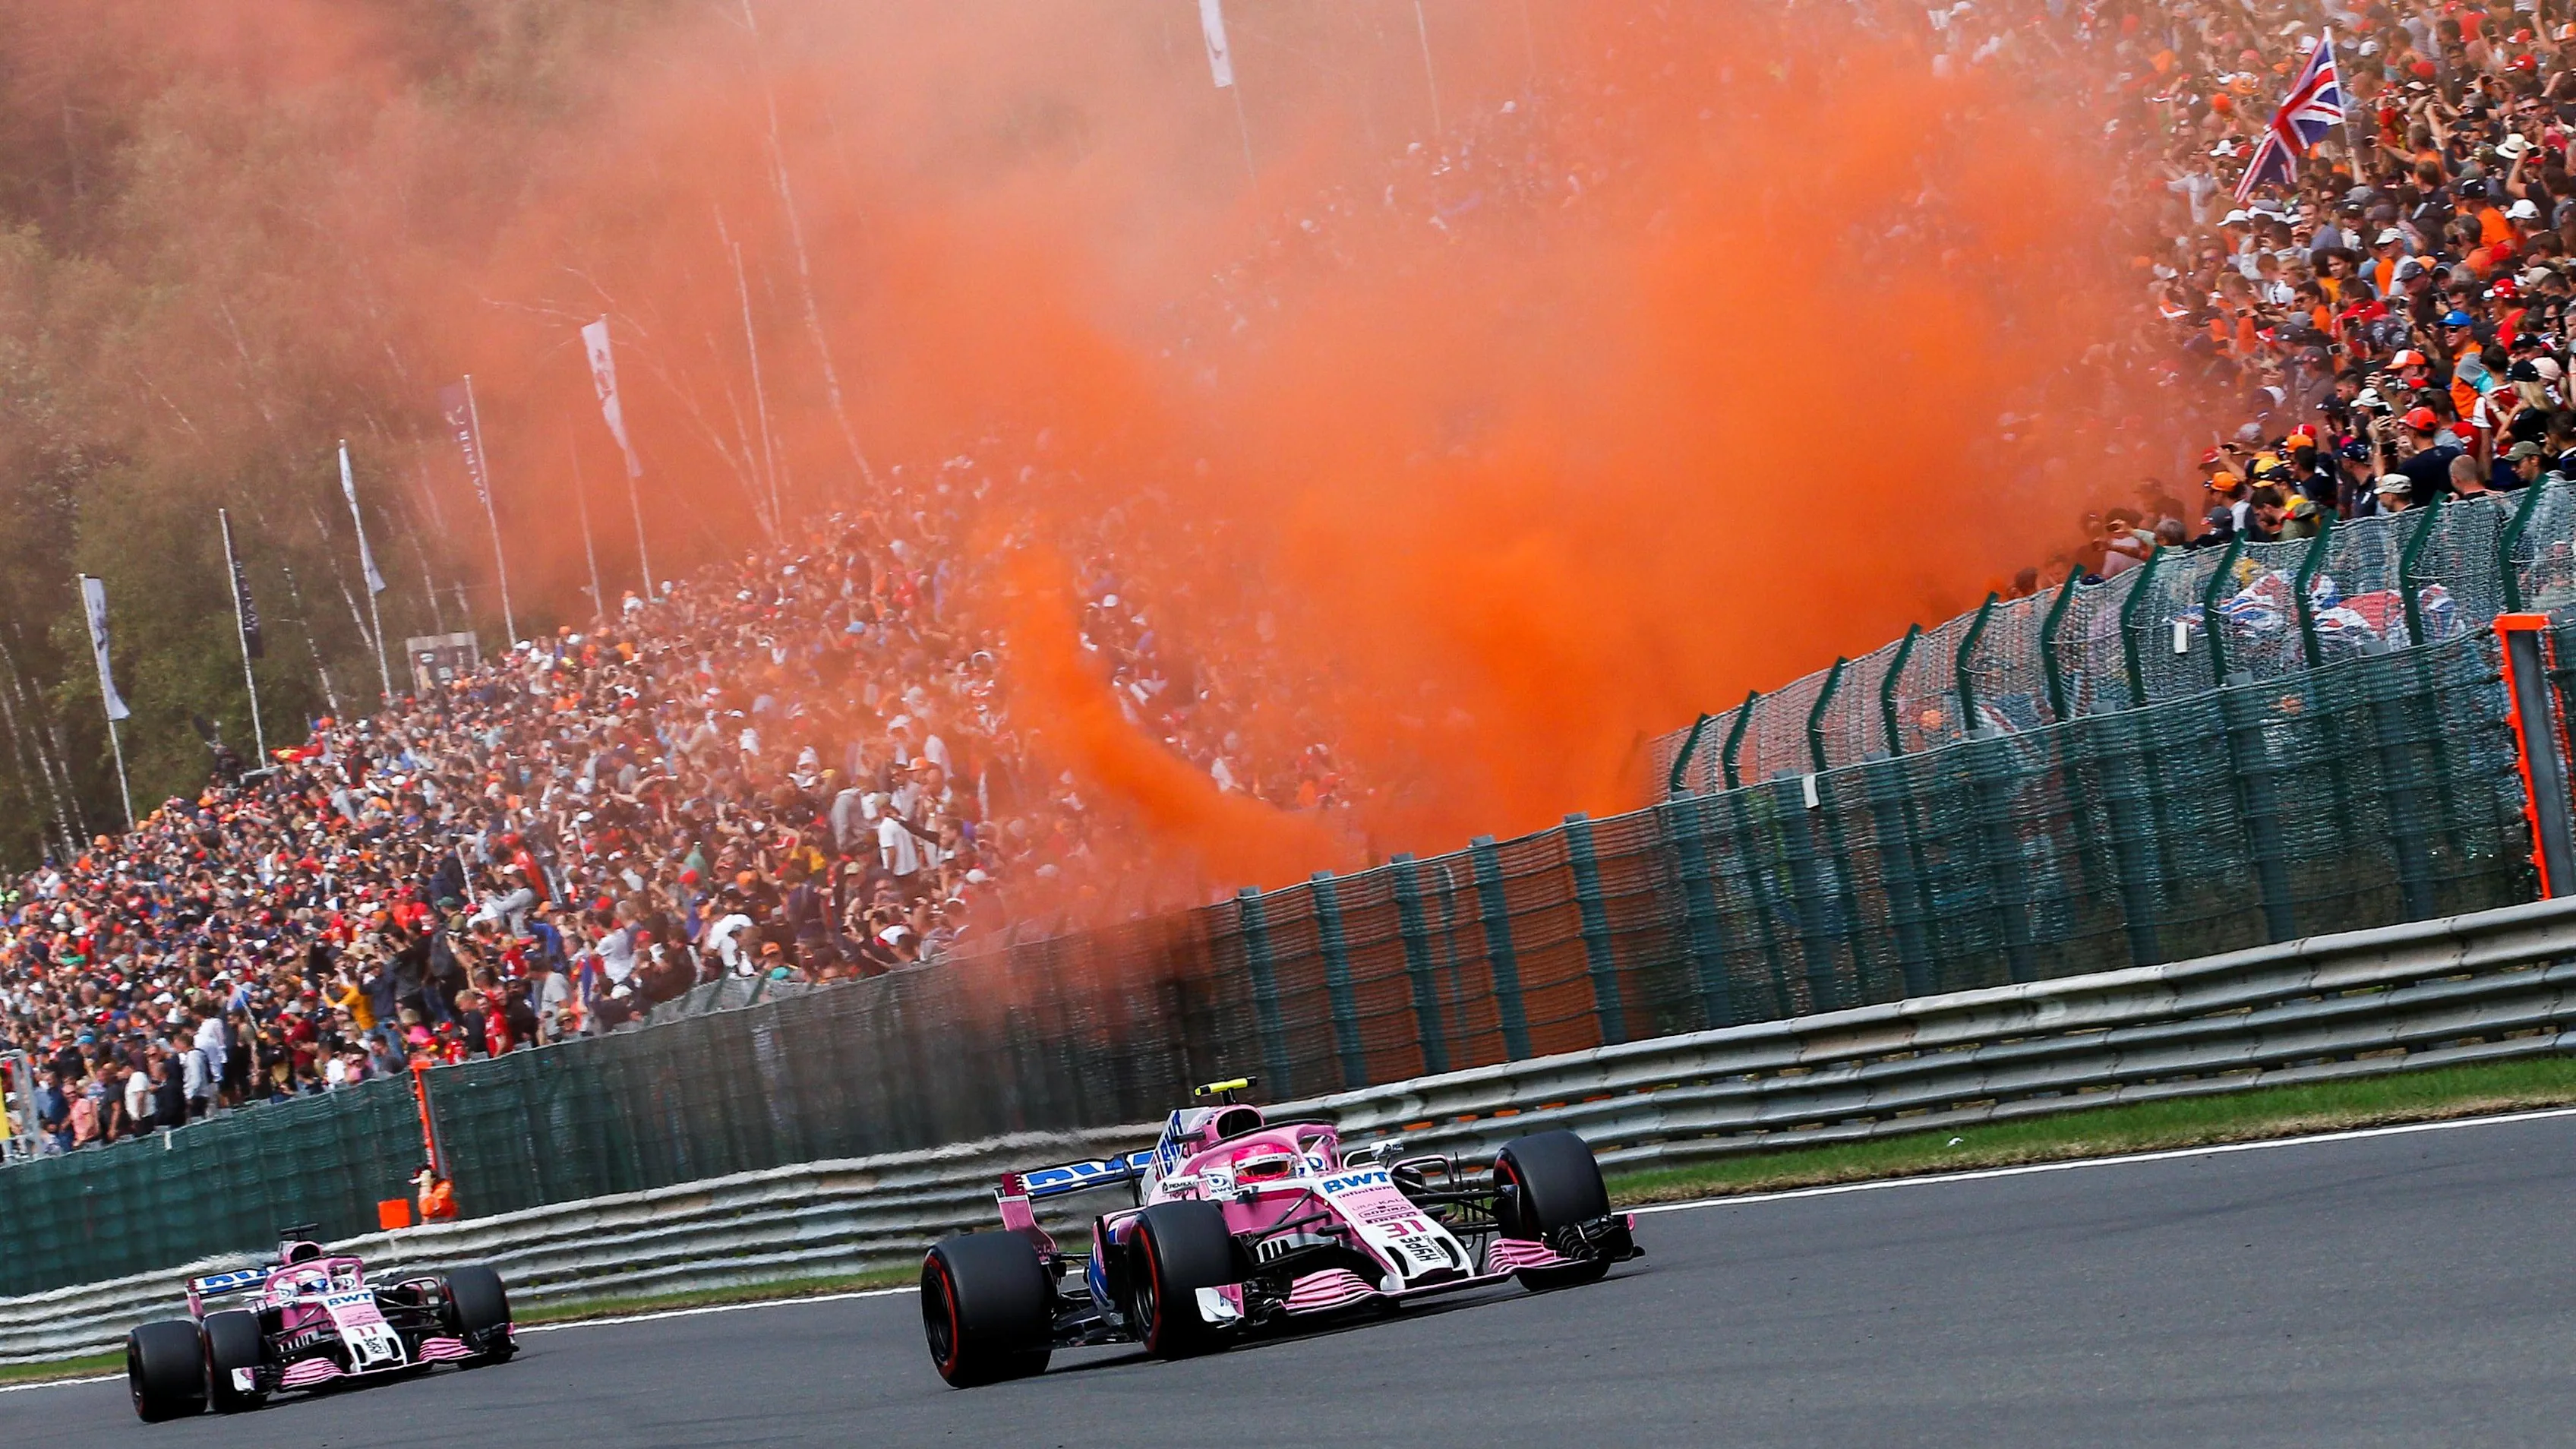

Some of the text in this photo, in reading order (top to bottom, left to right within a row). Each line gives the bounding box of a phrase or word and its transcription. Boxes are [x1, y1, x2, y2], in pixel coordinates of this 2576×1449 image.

[1323, 1172, 1388, 1194] BWT
[1376, 1220, 1427, 1239] 31
[1399, 1236, 1441, 1261] HYPE
[327, 1293, 371, 1306] BWT
[354, 1326, 377, 1337] 11
